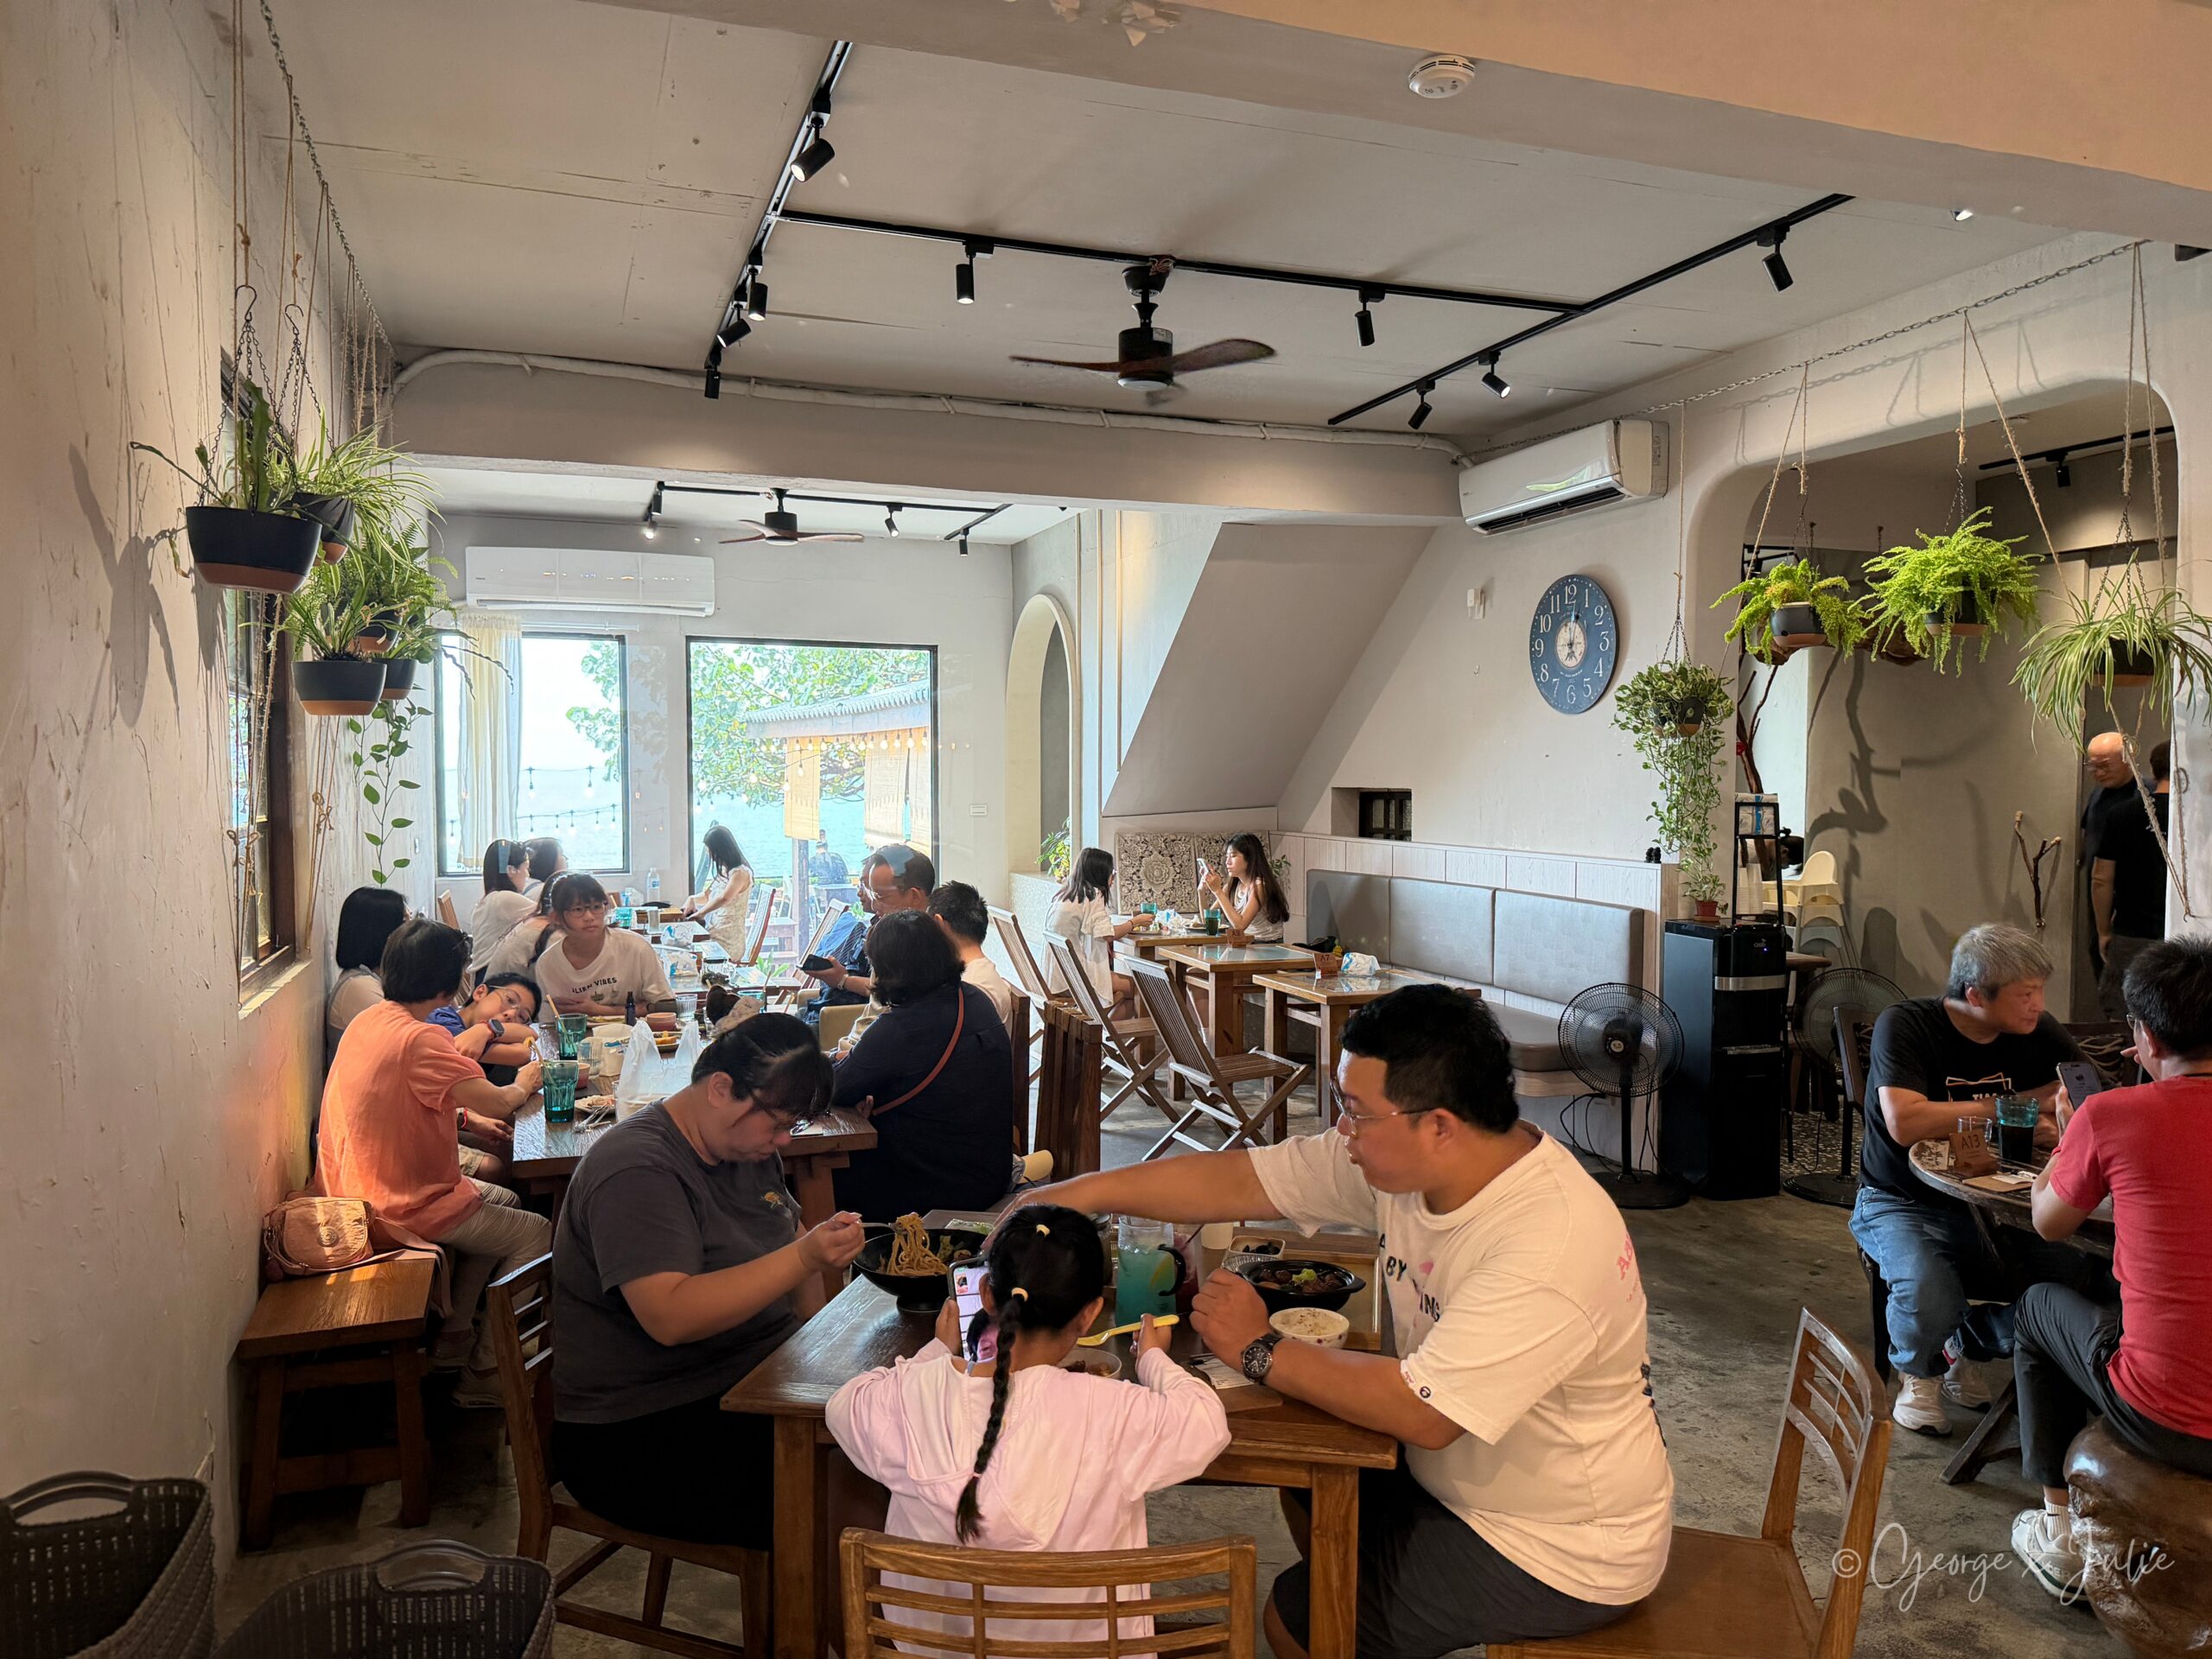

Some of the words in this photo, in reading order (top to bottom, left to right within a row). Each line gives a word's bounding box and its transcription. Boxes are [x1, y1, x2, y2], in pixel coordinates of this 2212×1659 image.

[1550, 594, 1560, 613] 11
[1564, 584, 1578, 605] 12
[1585, 588, 1589, 608] 1
[1540, 613, 1552, 633] 10
[1594, 605, 1605, 626] 2
[1535, 638, 1544, 658] 9
[1599, 631, 1610, 652] 3
[1540, 663, 1549, 683] 8
[1593, 657, 1604, 677] 4
[1552, 678, 1560, 697] 7
[1567, 684, 1577, 704] 6
[1583, 677, 1592, 697] 5
[1961, 1134, 1980, 1150] A13
